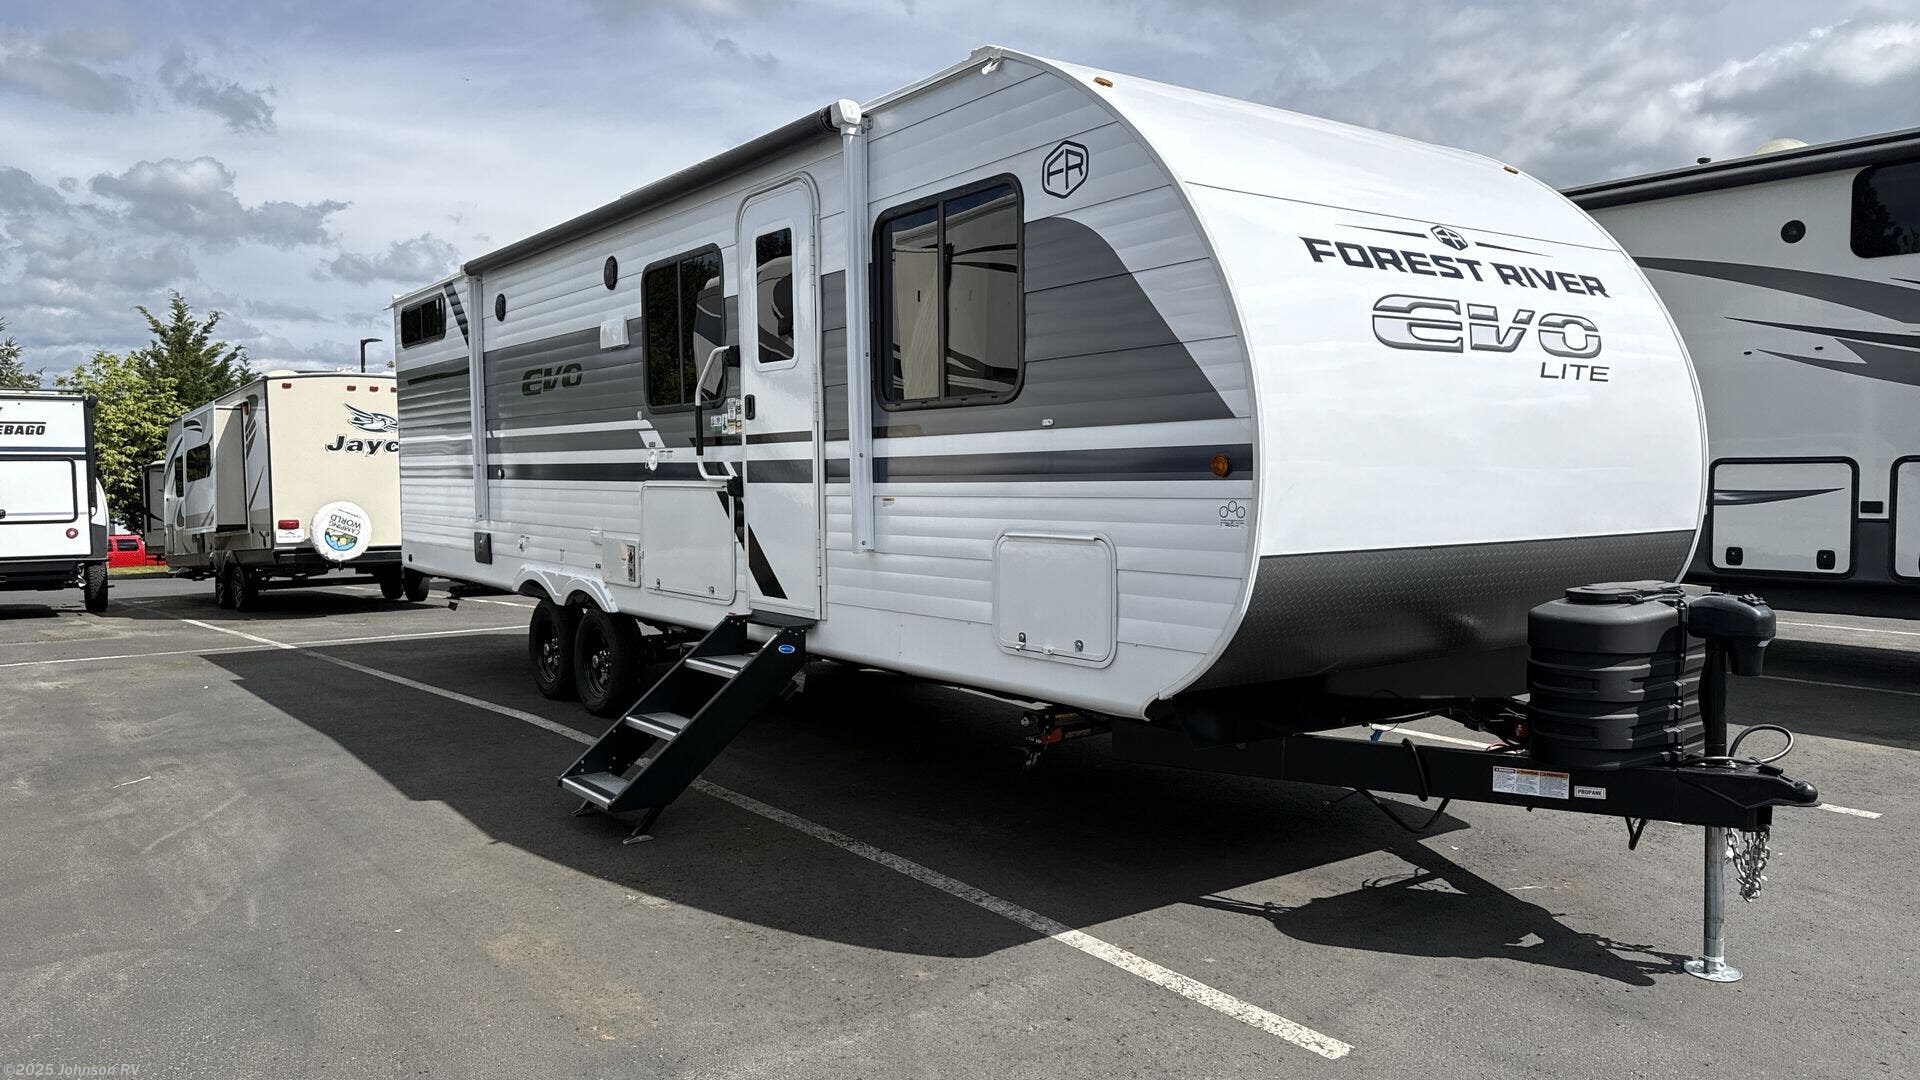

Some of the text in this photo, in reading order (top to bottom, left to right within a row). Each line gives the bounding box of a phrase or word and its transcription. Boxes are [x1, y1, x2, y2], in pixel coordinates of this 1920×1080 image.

[1298, 236, 1612, 299] FOREST RIVER
[1371, 293, 1602, 359] EVO
[521, 363, 583, 396] EVO
[1539, 362, 1610, 382] LITE
[328, 520, 361, 536] CAMPING
[330, 513, 362, 530] WORLD
[1577, 788, 1603, 797] PROPANE
